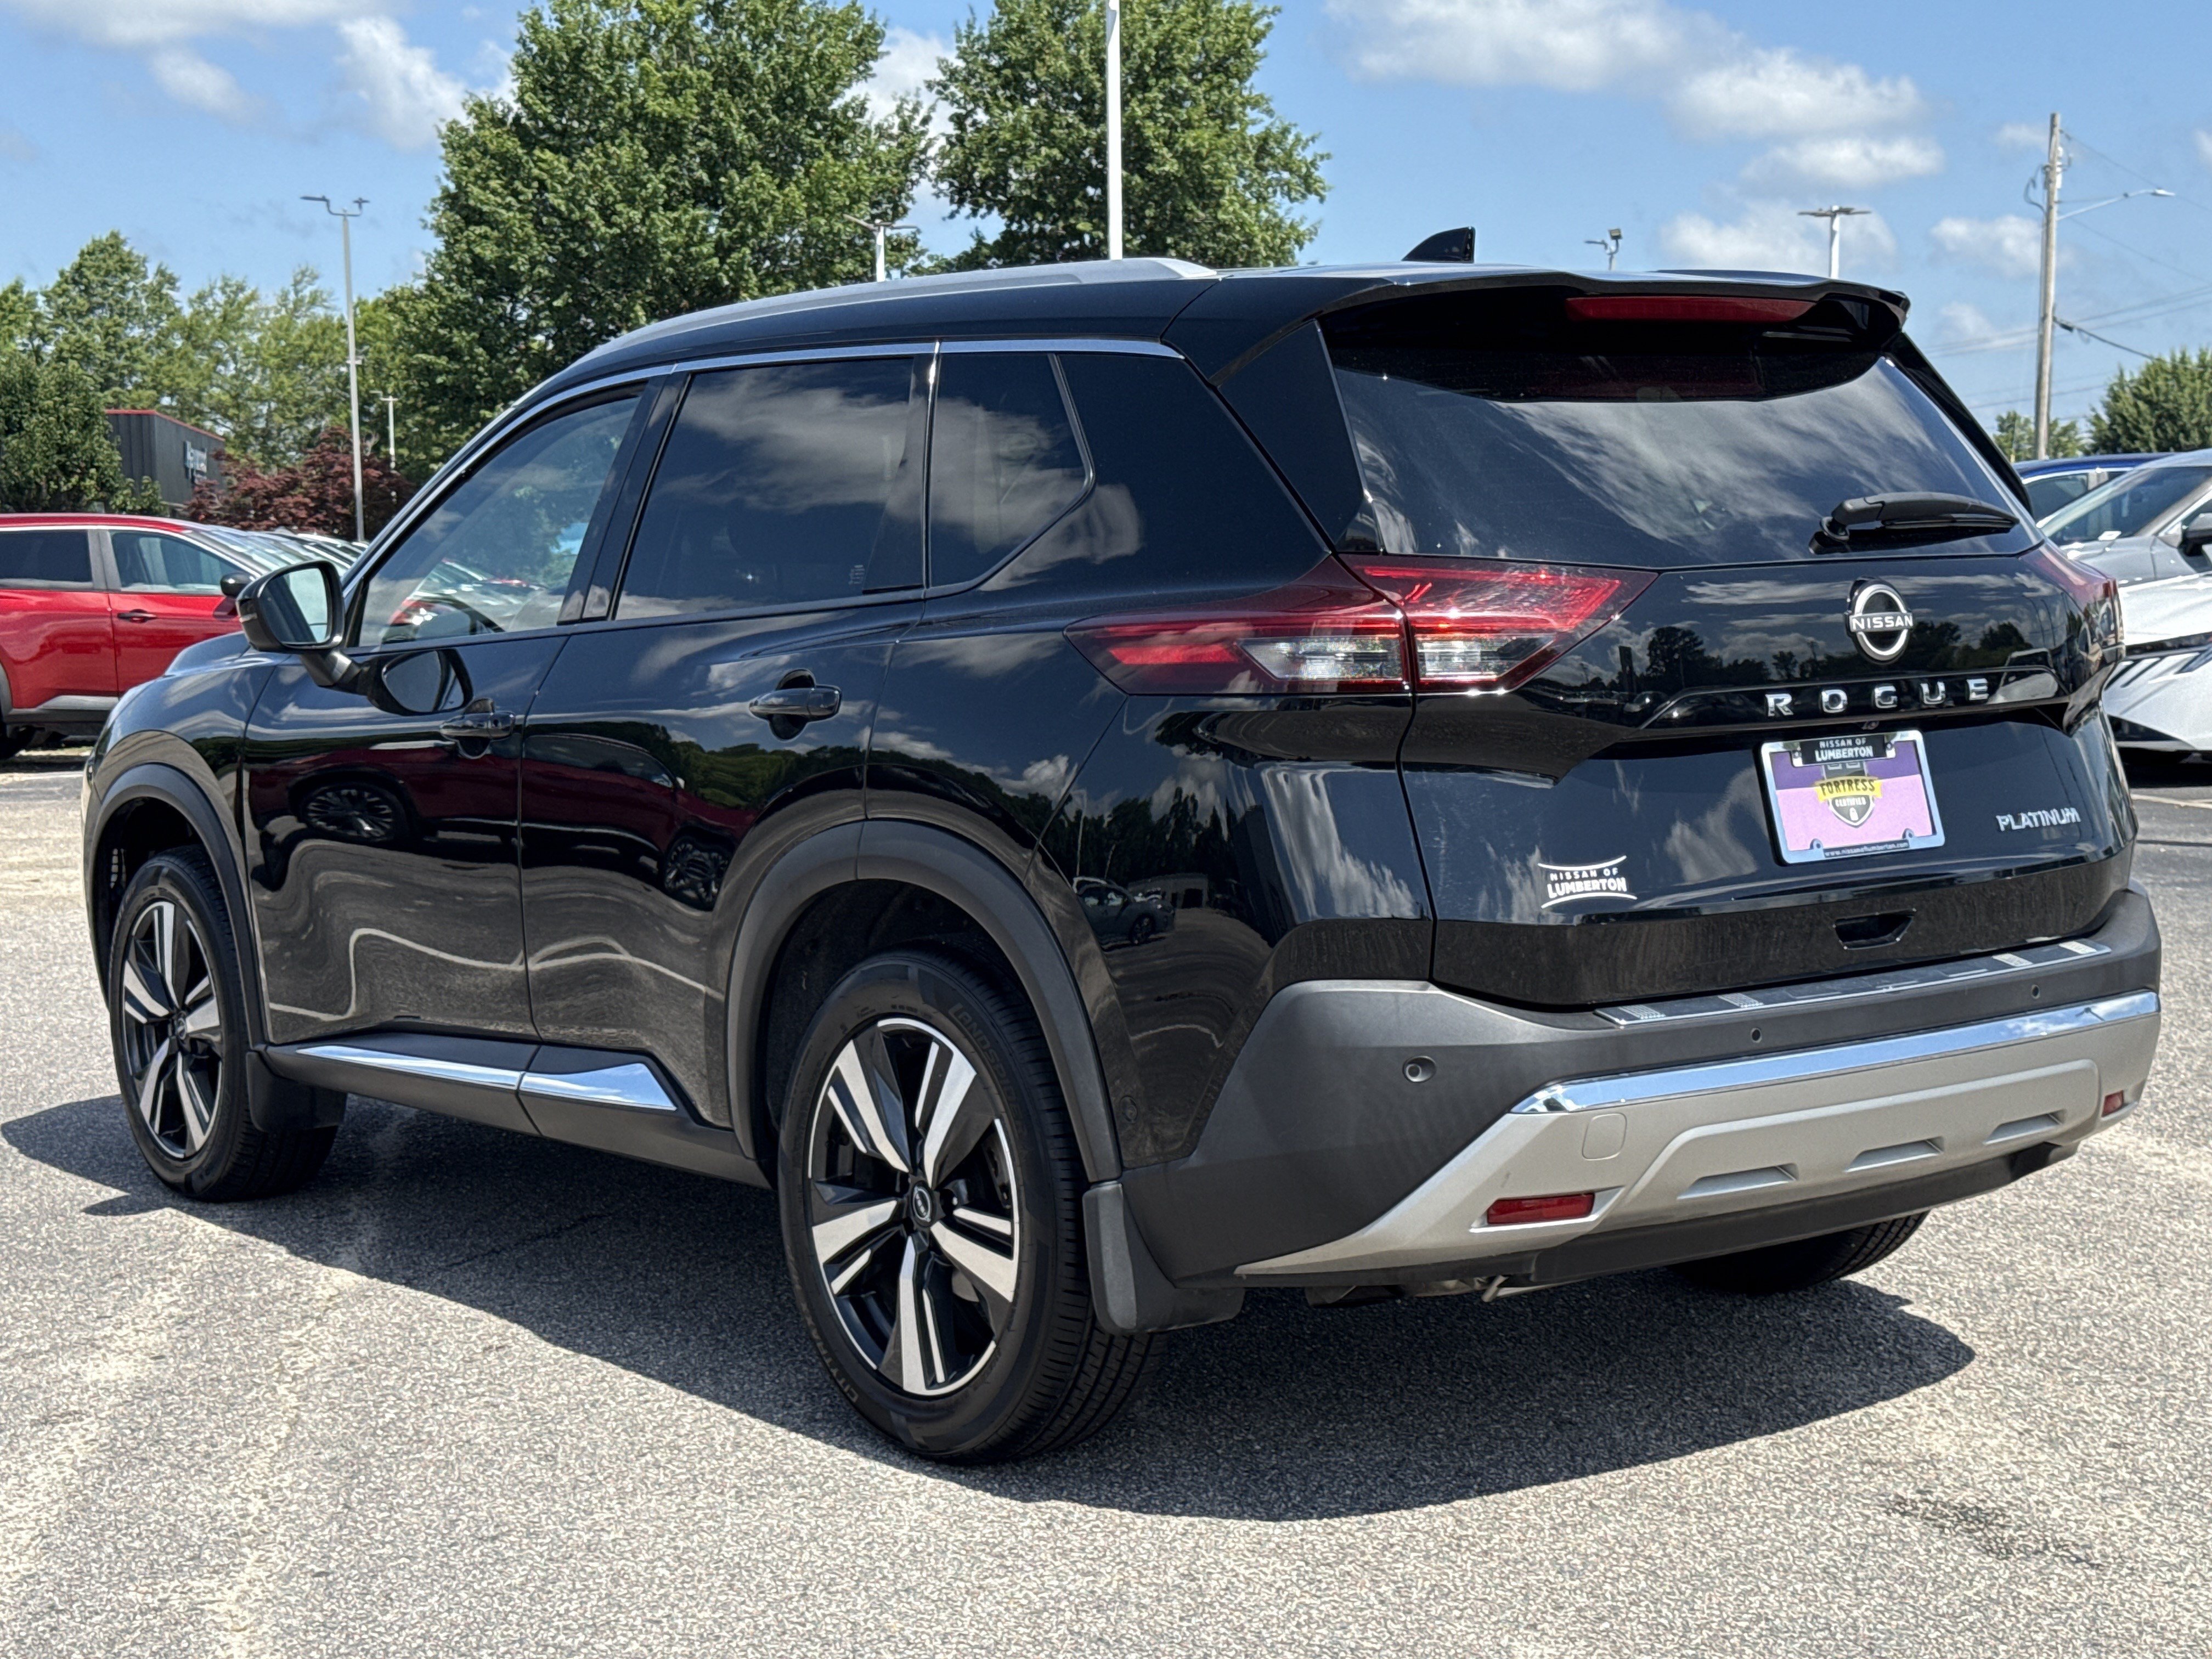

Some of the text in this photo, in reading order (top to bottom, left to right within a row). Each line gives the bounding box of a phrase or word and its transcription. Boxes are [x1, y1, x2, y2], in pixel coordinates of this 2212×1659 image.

[1852, 612, 1913, 630] NISSAN
[1765, 678, 1989, 716] ROGUE
[1819, 737, 1866, 748] NISSAN OF
[1815, 746, 1874, 762] LUMBERTON
[1820, 779, 1876, 797] FORTRESS
[1996, 807, 2081, 832] PLATINUM
[1550, 867, 1618, 882] NISSAN OF
[1547, 877, 1627, 899] LUMBERTON
